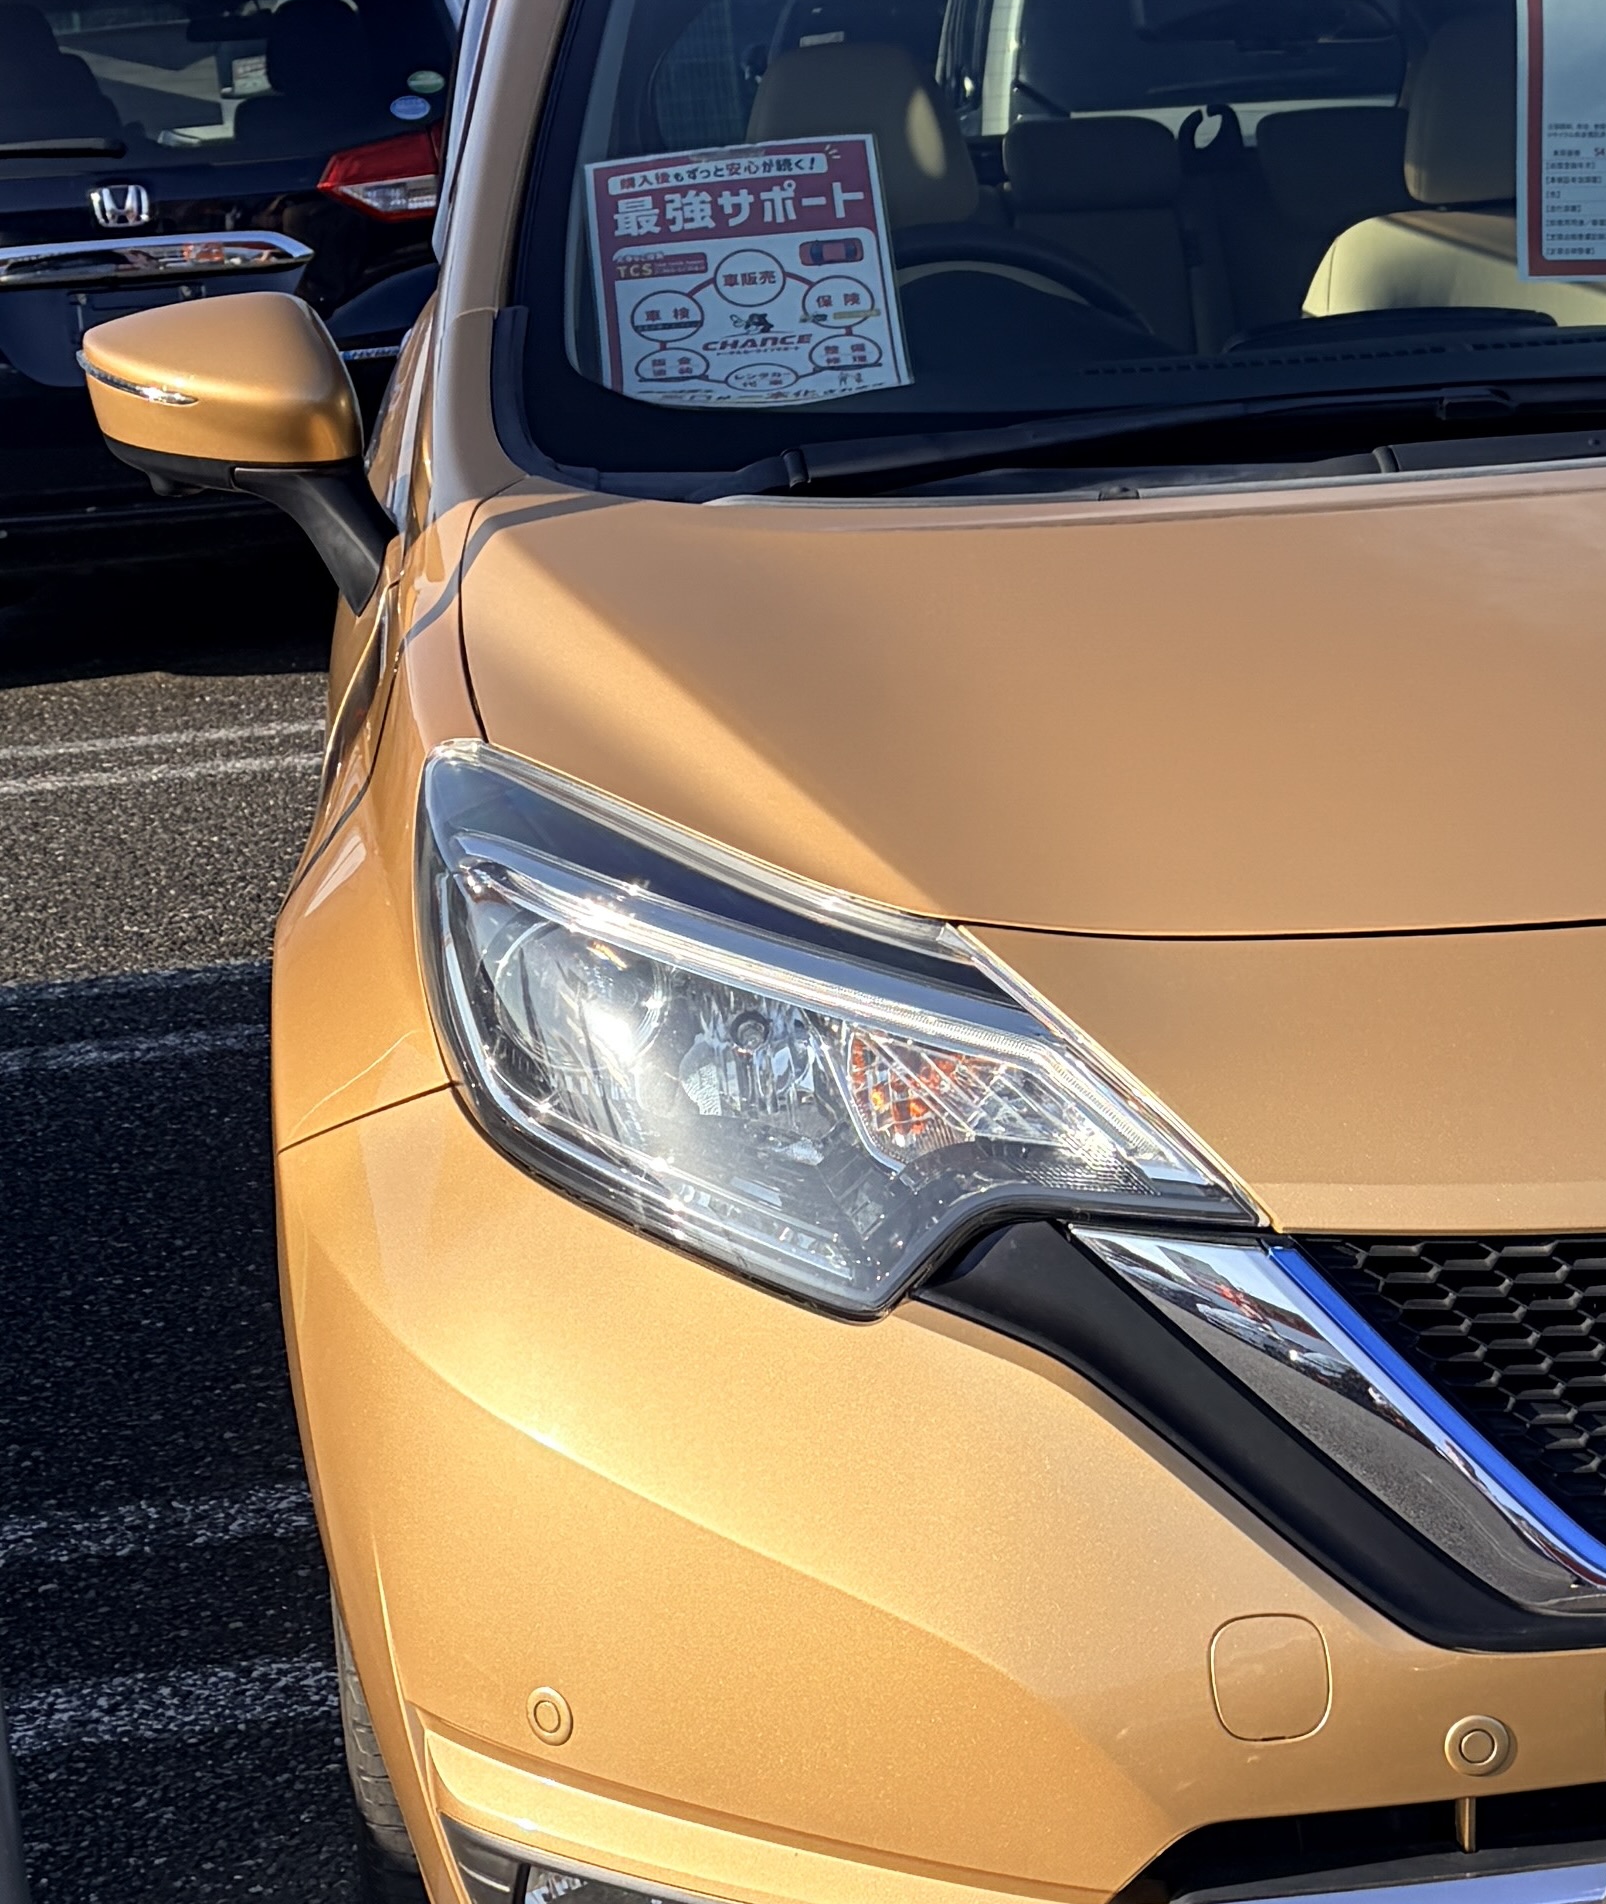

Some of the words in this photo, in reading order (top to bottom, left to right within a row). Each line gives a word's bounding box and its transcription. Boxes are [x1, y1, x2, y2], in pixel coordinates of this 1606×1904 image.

[613, 179, 865, 237] 最強サポート
[616, 262, 653, 279] TCS
[722, 270, 777, 287] 車販売
[815, 292, 861, 308] 保険
[644, 307, 690, 322] 車検
[702, 333, 813, 352] CHANCE
